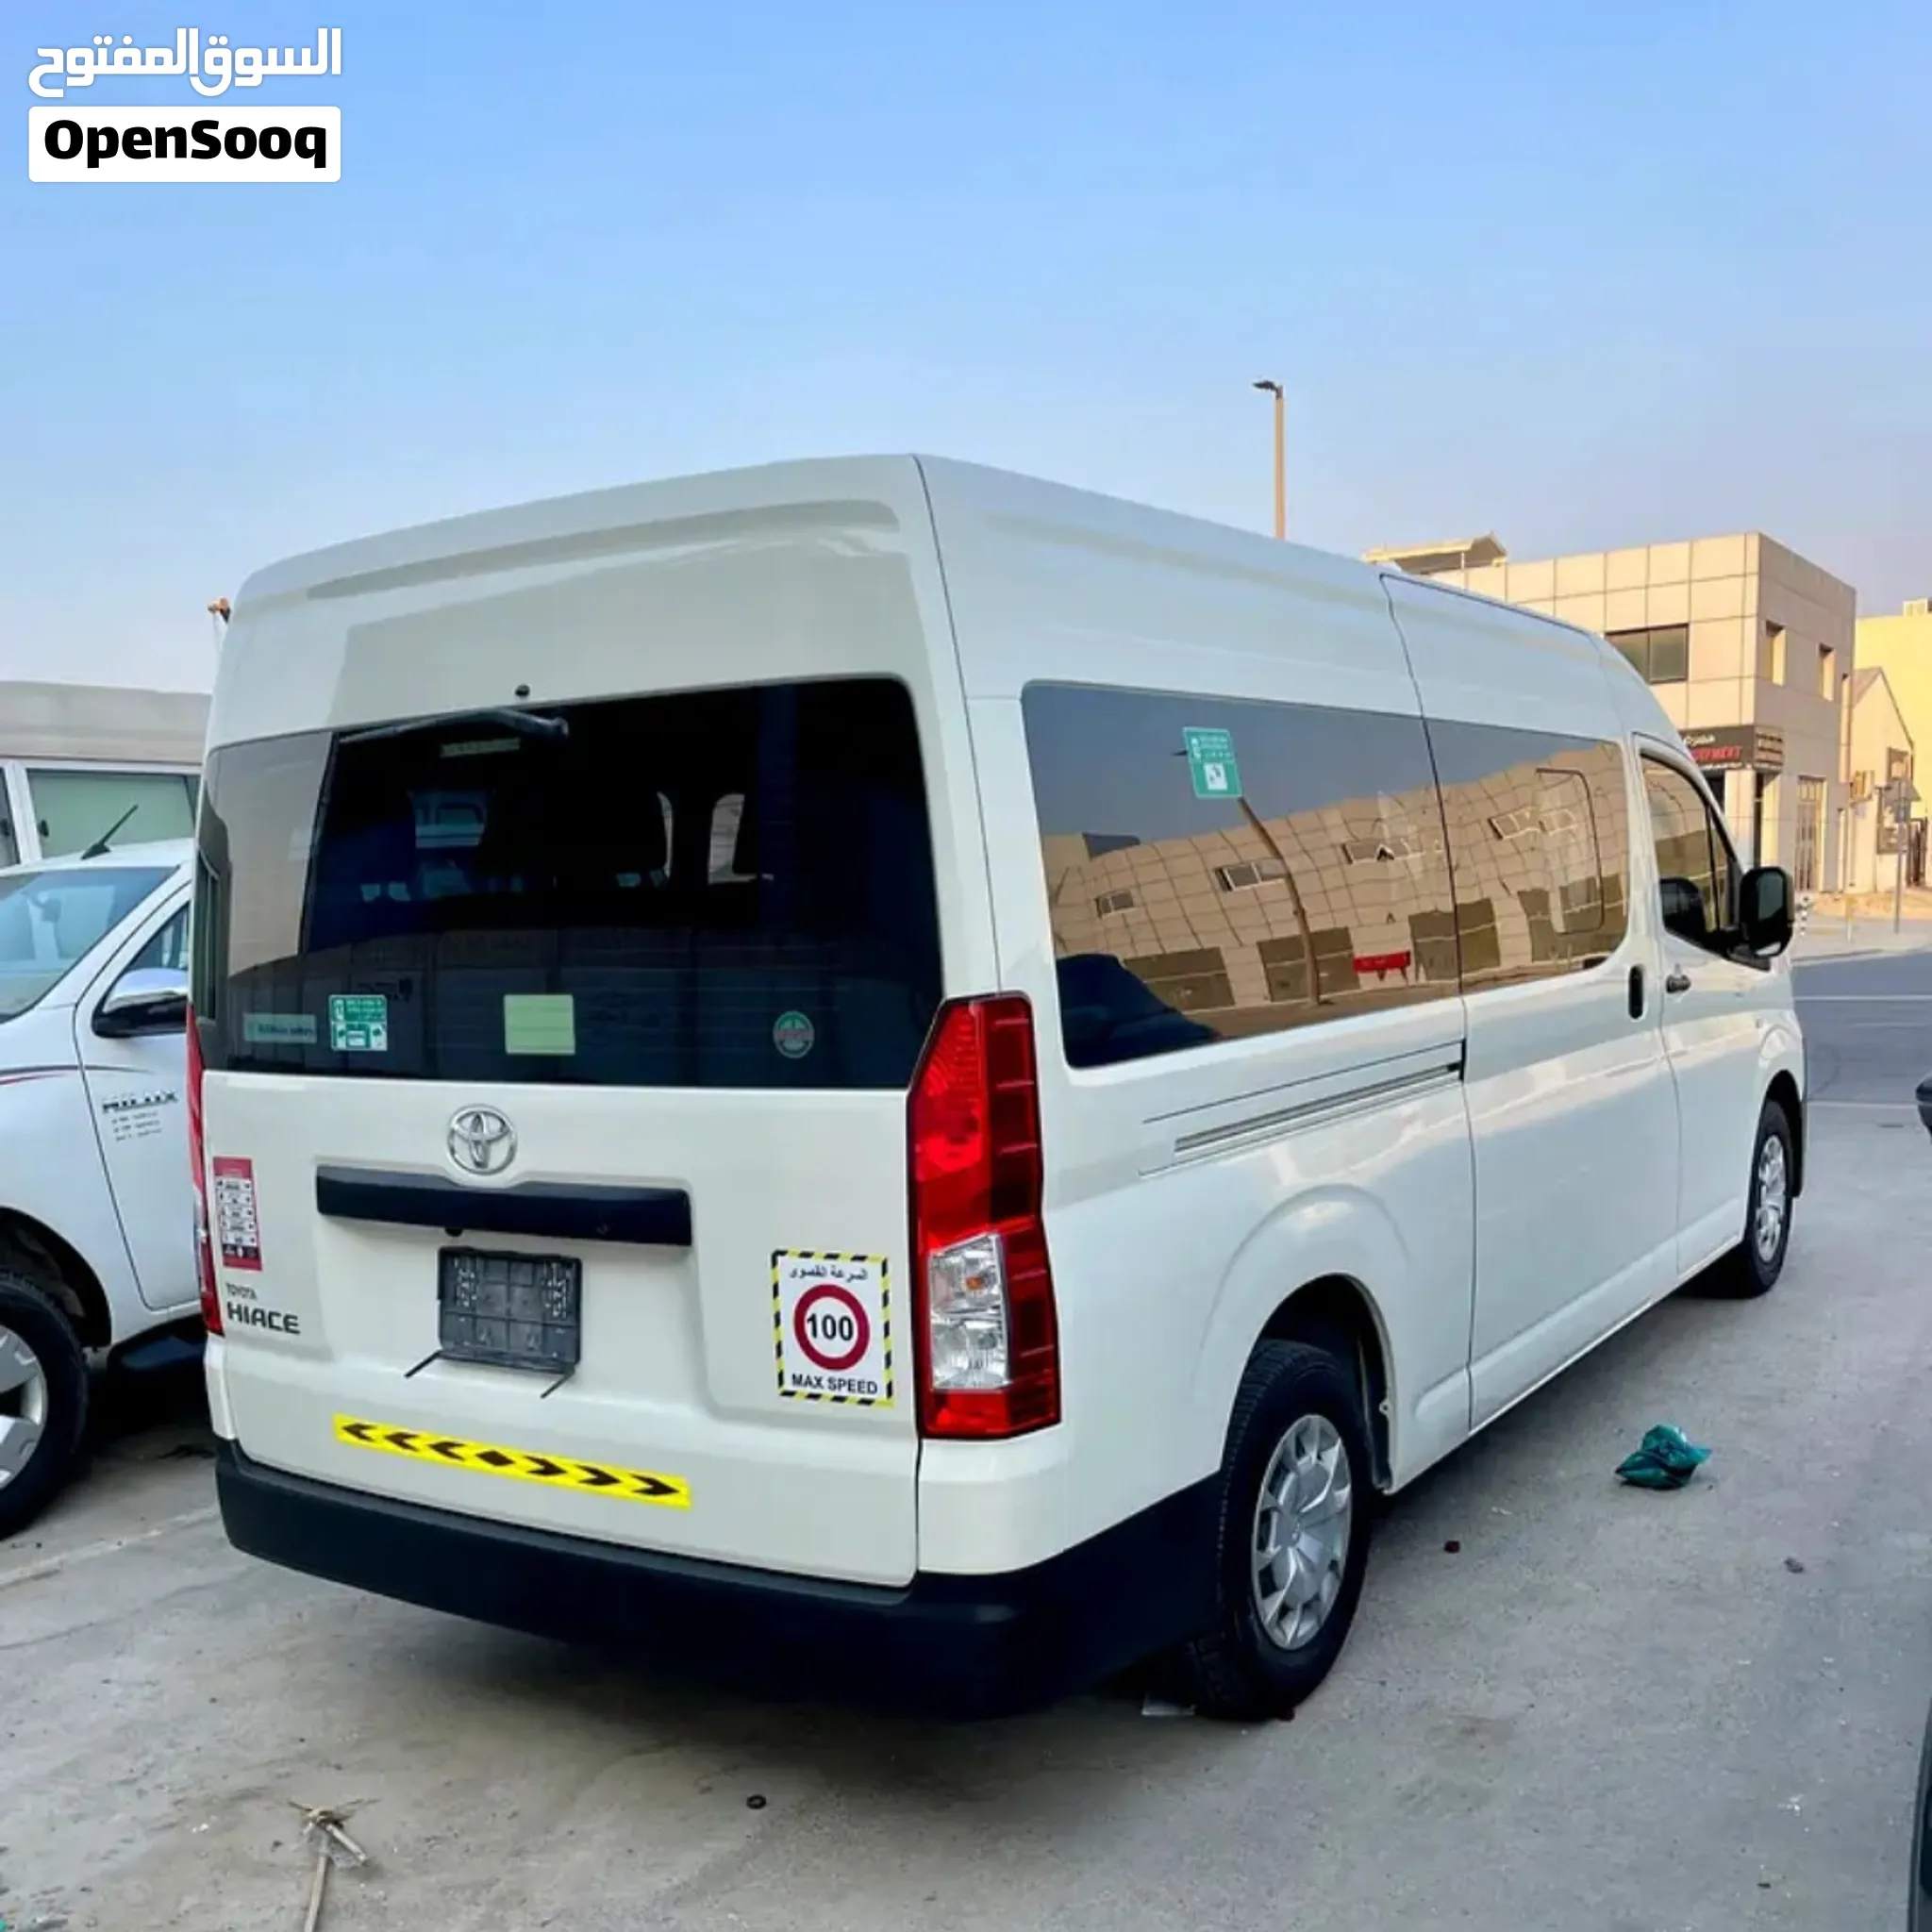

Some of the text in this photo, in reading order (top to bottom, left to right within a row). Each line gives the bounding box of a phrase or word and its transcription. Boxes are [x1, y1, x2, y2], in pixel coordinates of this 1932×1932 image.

[227, 1301, 301, 1335] HIACE
[807, 1312, 854, 1341] 100
[791, 1374, 878, 1395] MAX SPEED
